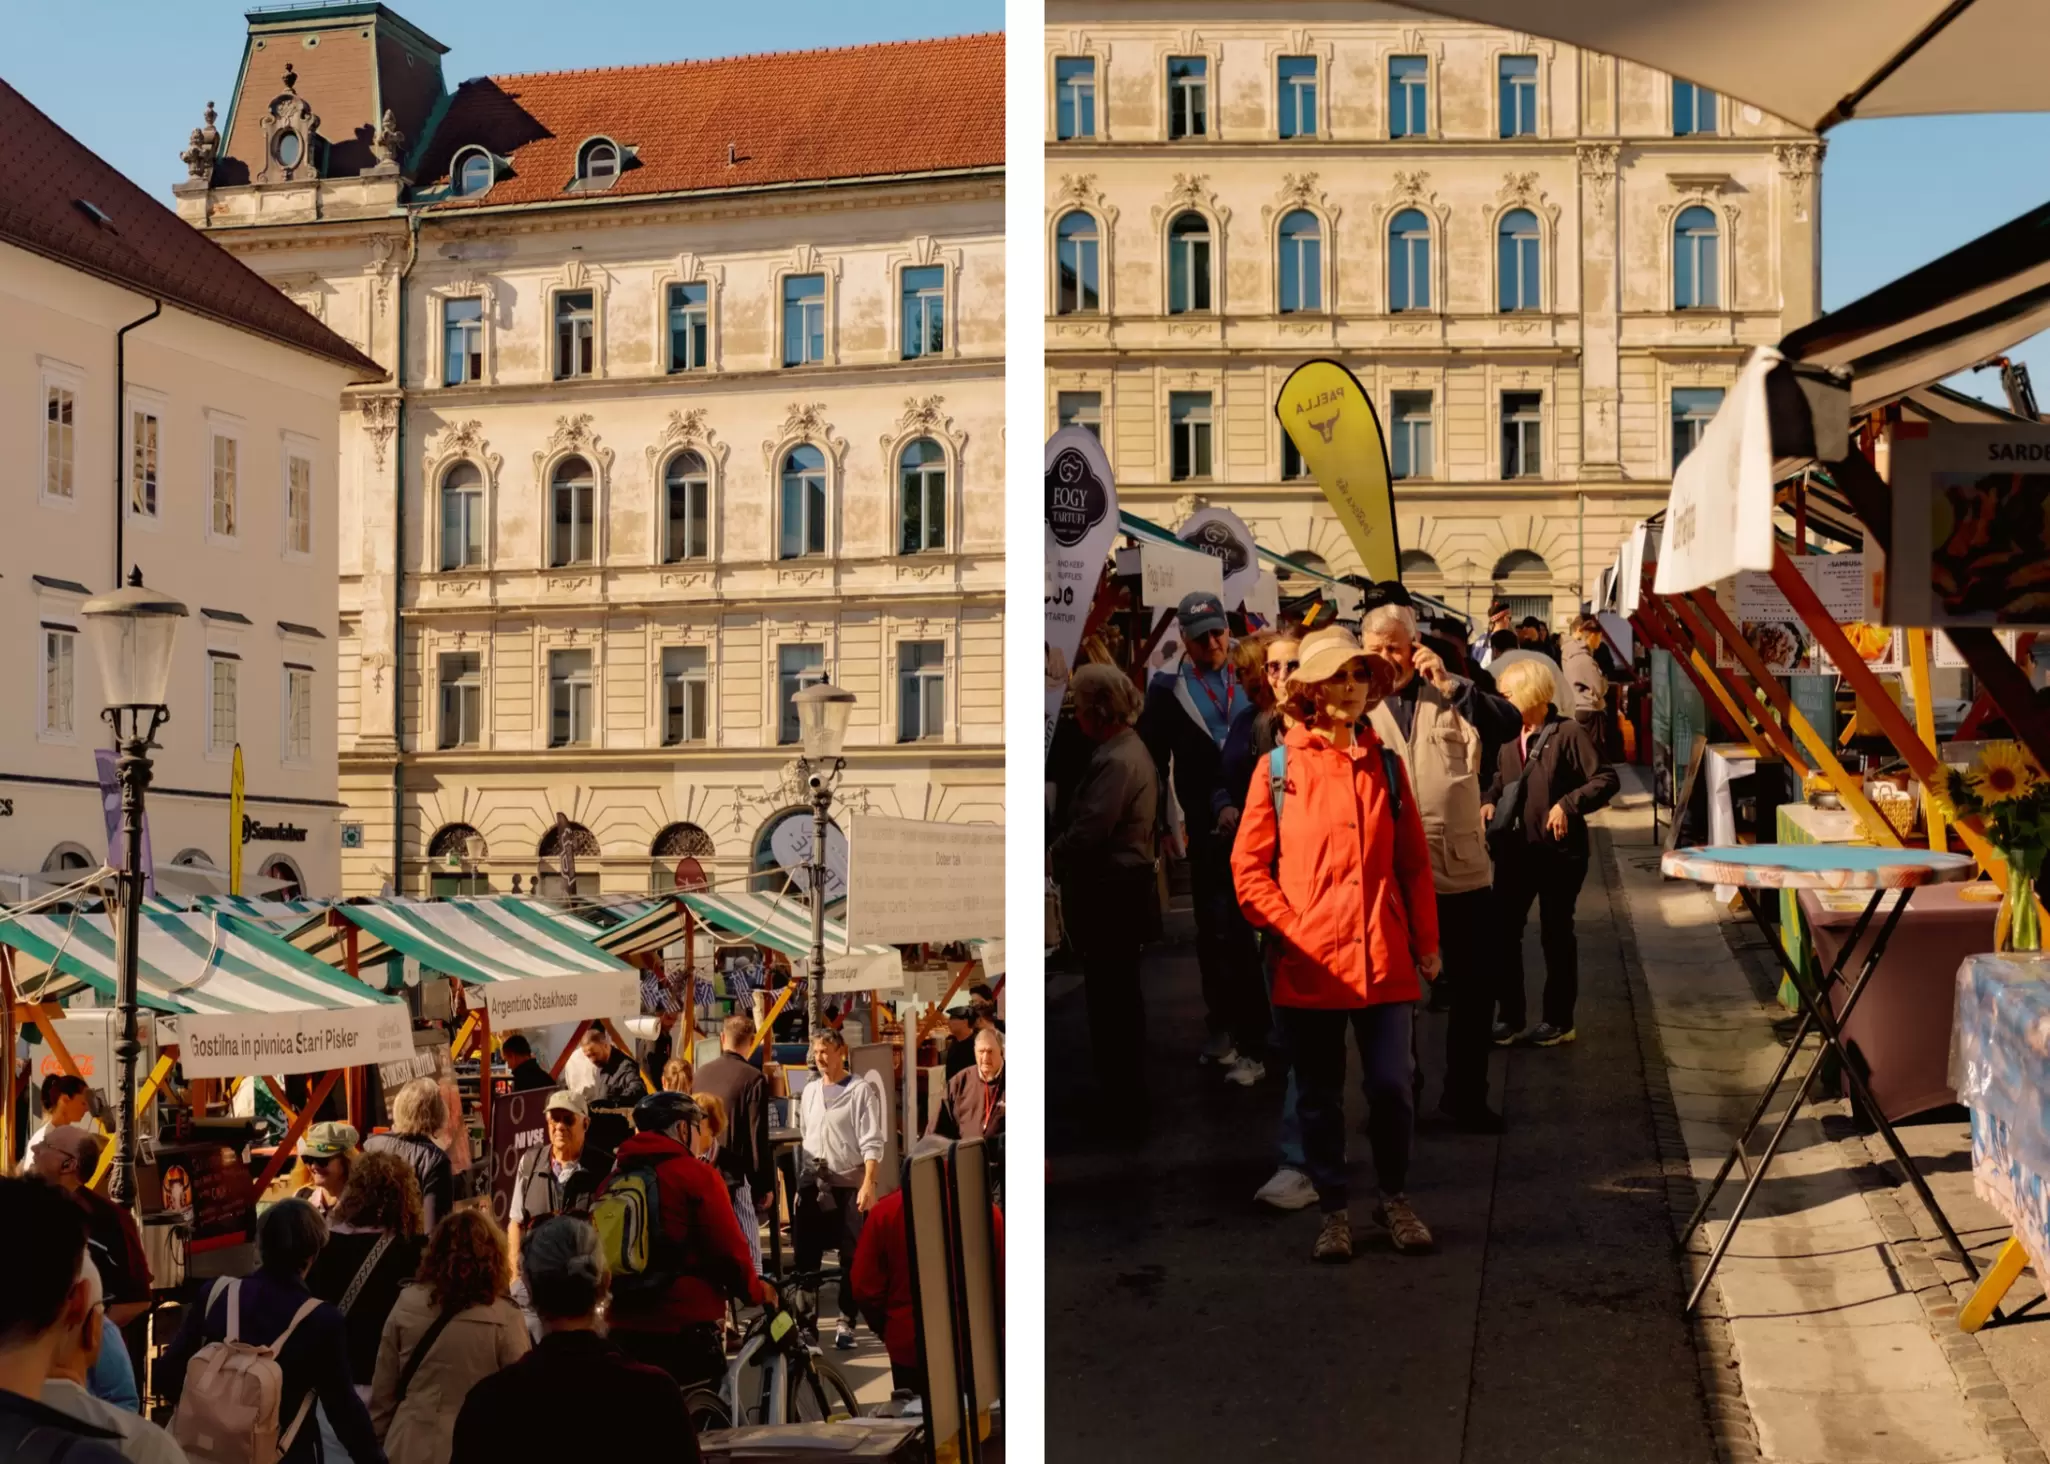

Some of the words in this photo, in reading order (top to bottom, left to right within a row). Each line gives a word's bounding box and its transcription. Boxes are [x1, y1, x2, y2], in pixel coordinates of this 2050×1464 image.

[1053, 487, 1088, 507] FOGY
[1052, 511, 1086, 524] TARTUFI
[533, 990, 578, 1010] Steakhouse
[190, 1033, 239, 1057] Gostilna
[241, 1033, 251, 1055] in
[253, 1033, 294, 1061] pivnica
[295, 1029, 324, 1055] Stari
[325, 1028, 359, 1049] Pisker
[515, 1132, 526, 1149] NI
[526, 1127, 544, 1147] VSE
